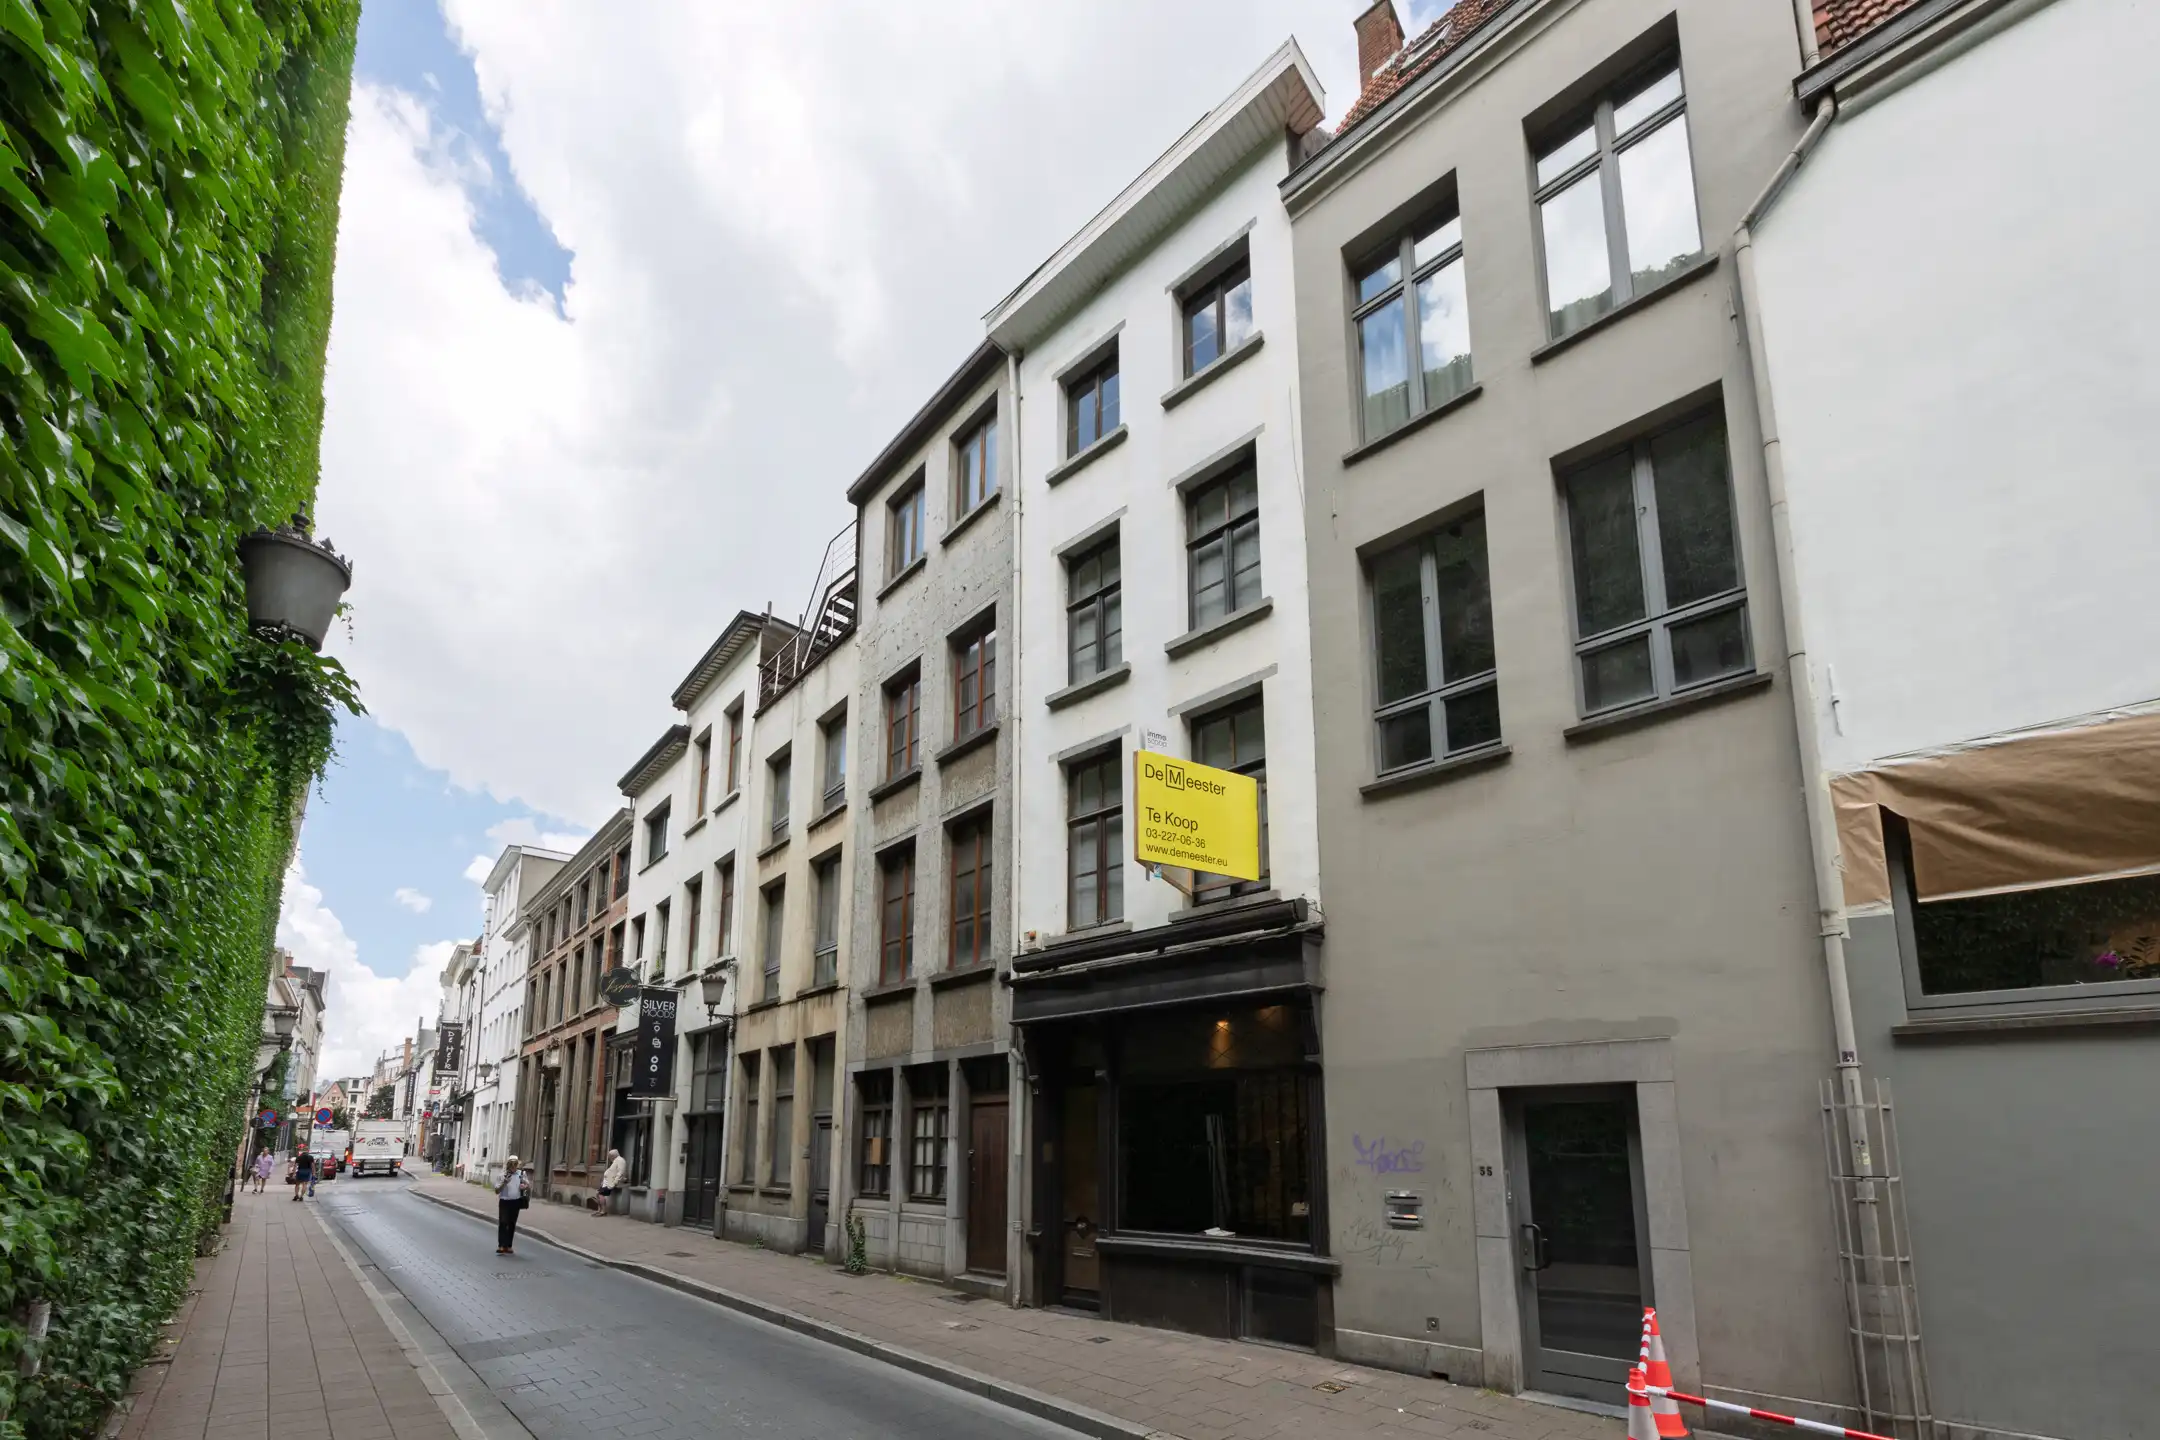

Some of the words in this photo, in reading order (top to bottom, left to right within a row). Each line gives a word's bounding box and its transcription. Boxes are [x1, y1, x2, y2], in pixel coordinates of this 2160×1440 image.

[1147, 728, 1167, 741] immo
[1145, 806, 1161, 824] Te
[1165, 810, 1199, 834] Koop
[1145, 827, 1206, 849] 03-227-06-36
[1145, 843, 1228, 867] www.demeester.eu
[642, 999, 676, 1011] SILVER
[641, 1008, 675, 1019] MOODS
[1479, 1165, 1493, 1177] 55
